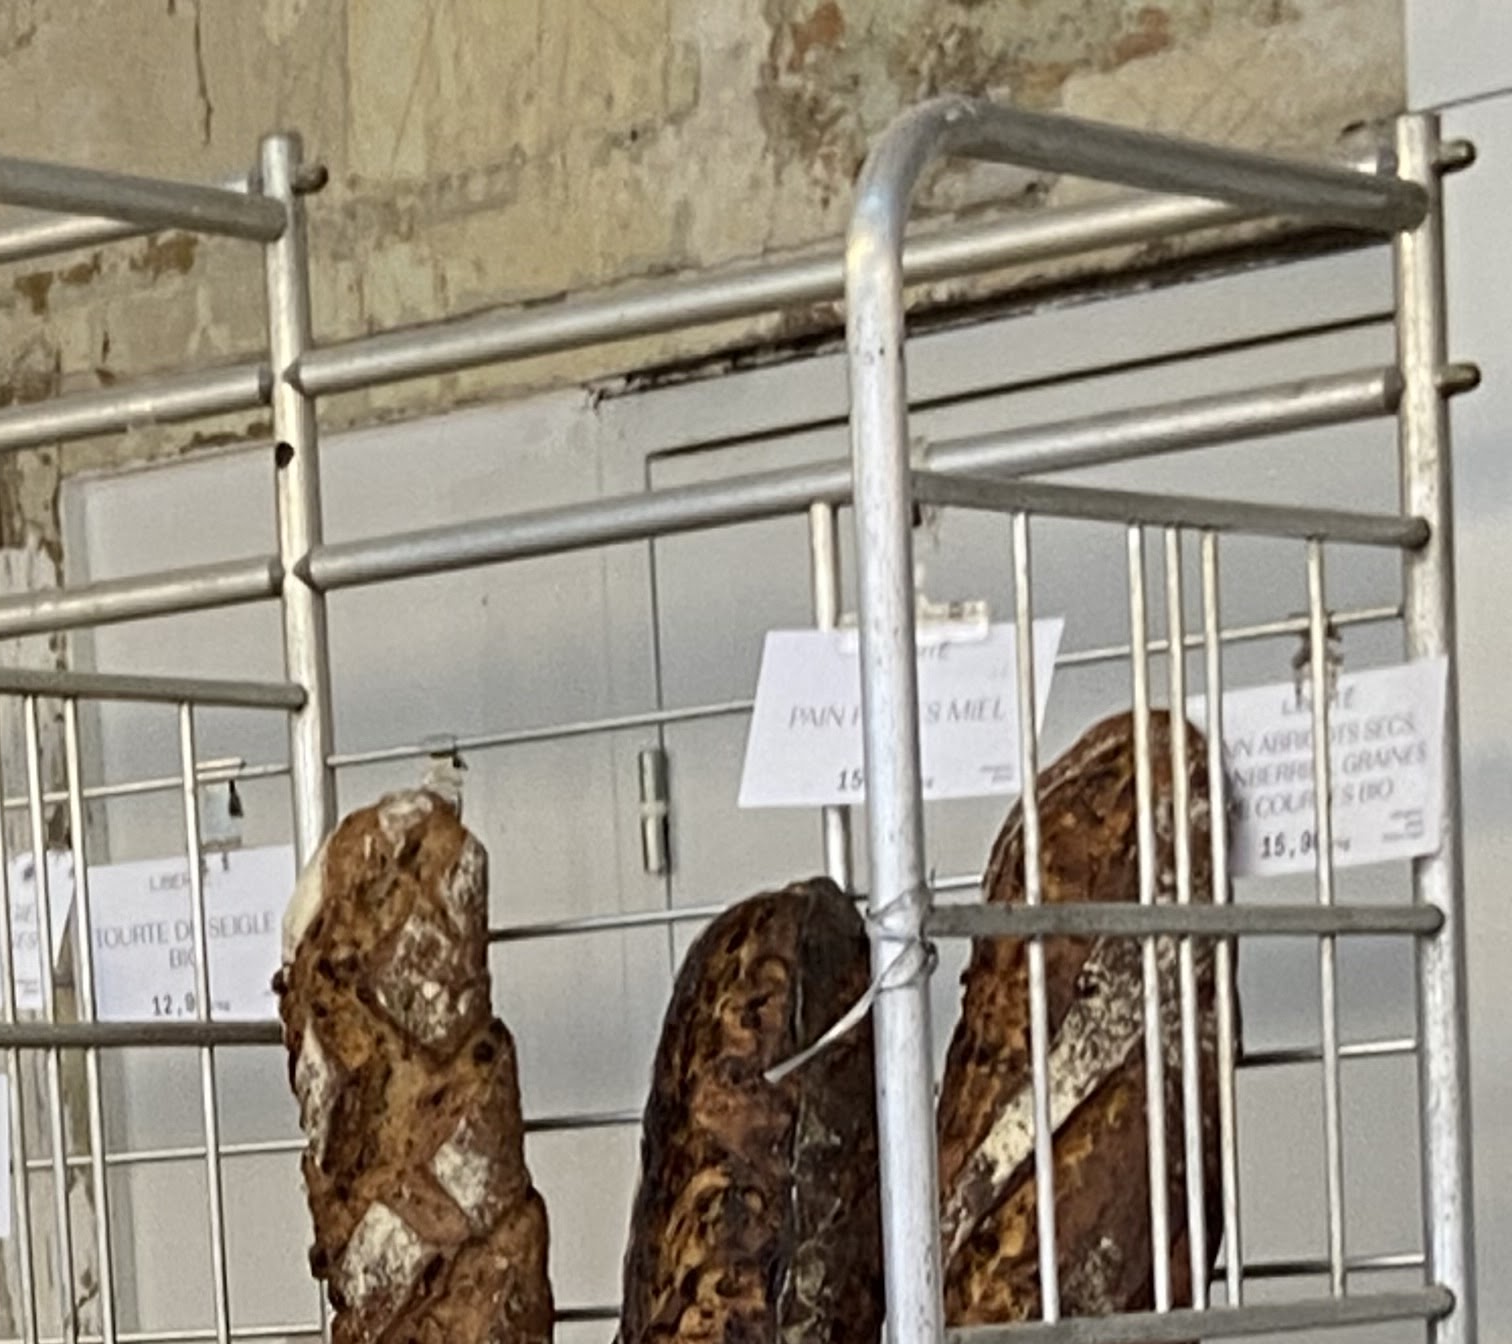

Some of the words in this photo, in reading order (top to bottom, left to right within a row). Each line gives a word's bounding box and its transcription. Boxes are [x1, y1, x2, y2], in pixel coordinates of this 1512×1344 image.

[788, 705, 844, 729] PAIN
[96, 921, 169, 950] TOURTE
[209, 911, 276, 940] SEIGLE
